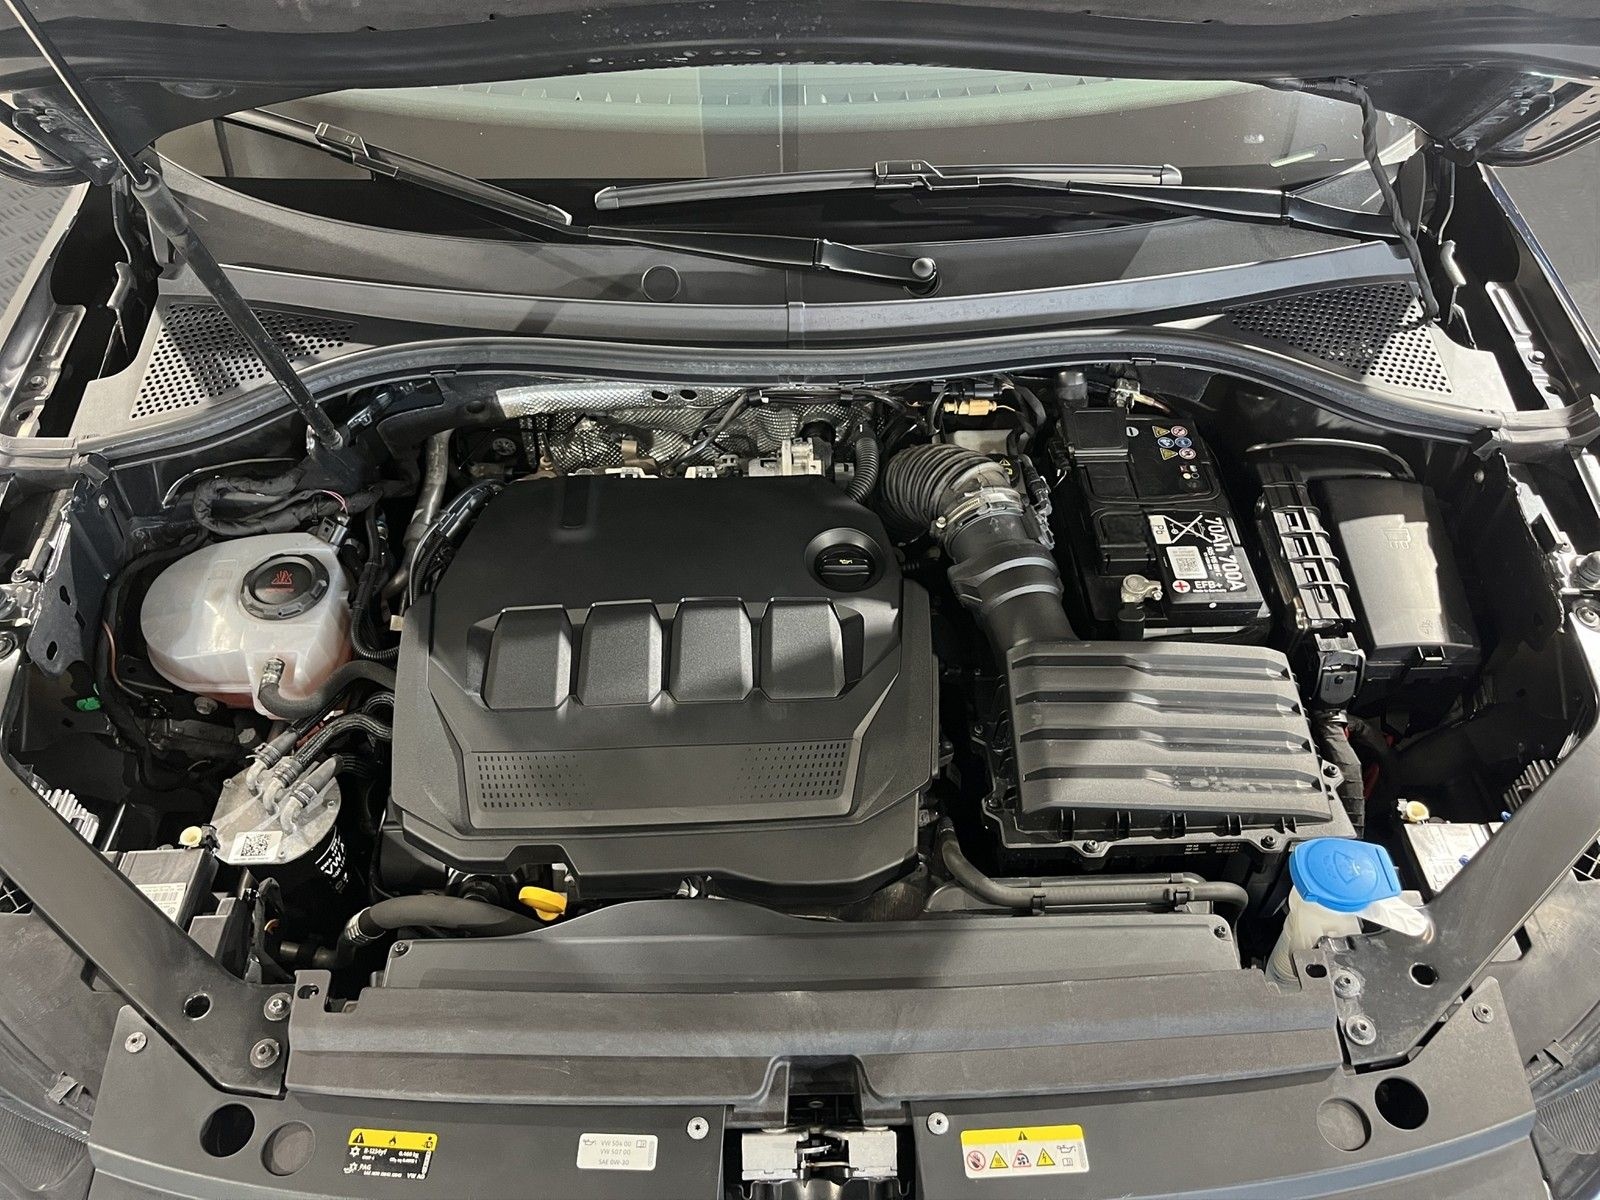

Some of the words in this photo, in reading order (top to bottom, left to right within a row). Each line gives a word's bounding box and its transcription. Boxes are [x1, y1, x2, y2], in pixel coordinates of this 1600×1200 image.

[1204, 517, 1231, 552] 70Ah
[1218, 554, 1247, 591] 700A
[1194, 580, 1223, 589] EFB+
[324, 851, 342, 875] VW
